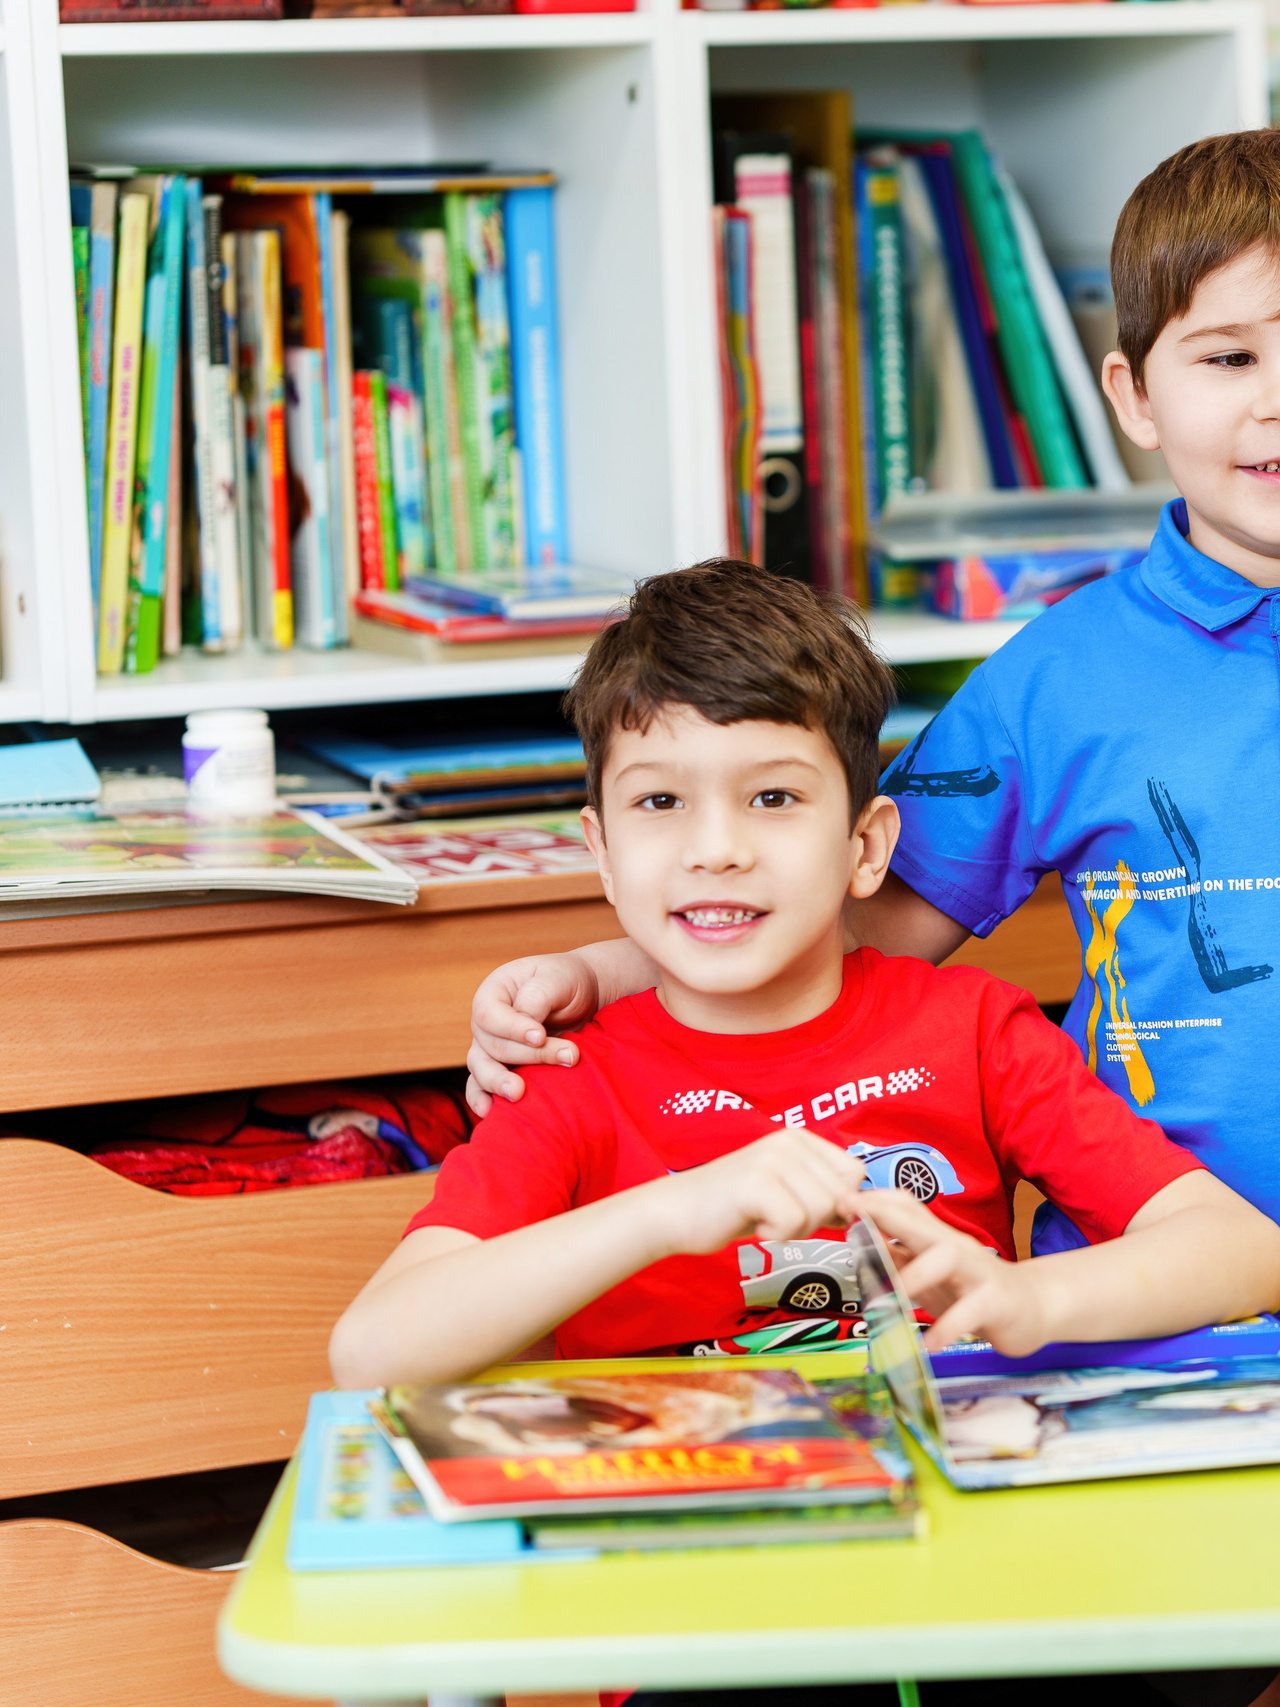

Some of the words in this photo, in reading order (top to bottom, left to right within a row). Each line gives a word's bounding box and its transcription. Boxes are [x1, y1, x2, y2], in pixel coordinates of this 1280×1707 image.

[1092, 870, 1140, 883] ORGANICALLY
[1141, 866, 1187, 883] GROWN
[1125, 889, 1142, 900] AND
[1203, 879, 1224, 892] ON
[1228, 878, 1254, 891] THE
[1105, 1021, 1138, 1030] UNIVERSAL
[1138, 1019, 1174, 1030] FASHION
[1174, 1018, 1223, 1029] ENTERPRISE
[1105, 1031, 1161, 1041] TECHNOLOGICAL
[1106, 1043, 1137, 1052] CLOTHING
[1106, 1053, 1132, 1062] SYSTEM
[715, 1089, 807, 1129] RE
[811, 1075, 883, 1121] CAR
[783, 1246, 803, 1261] 88
